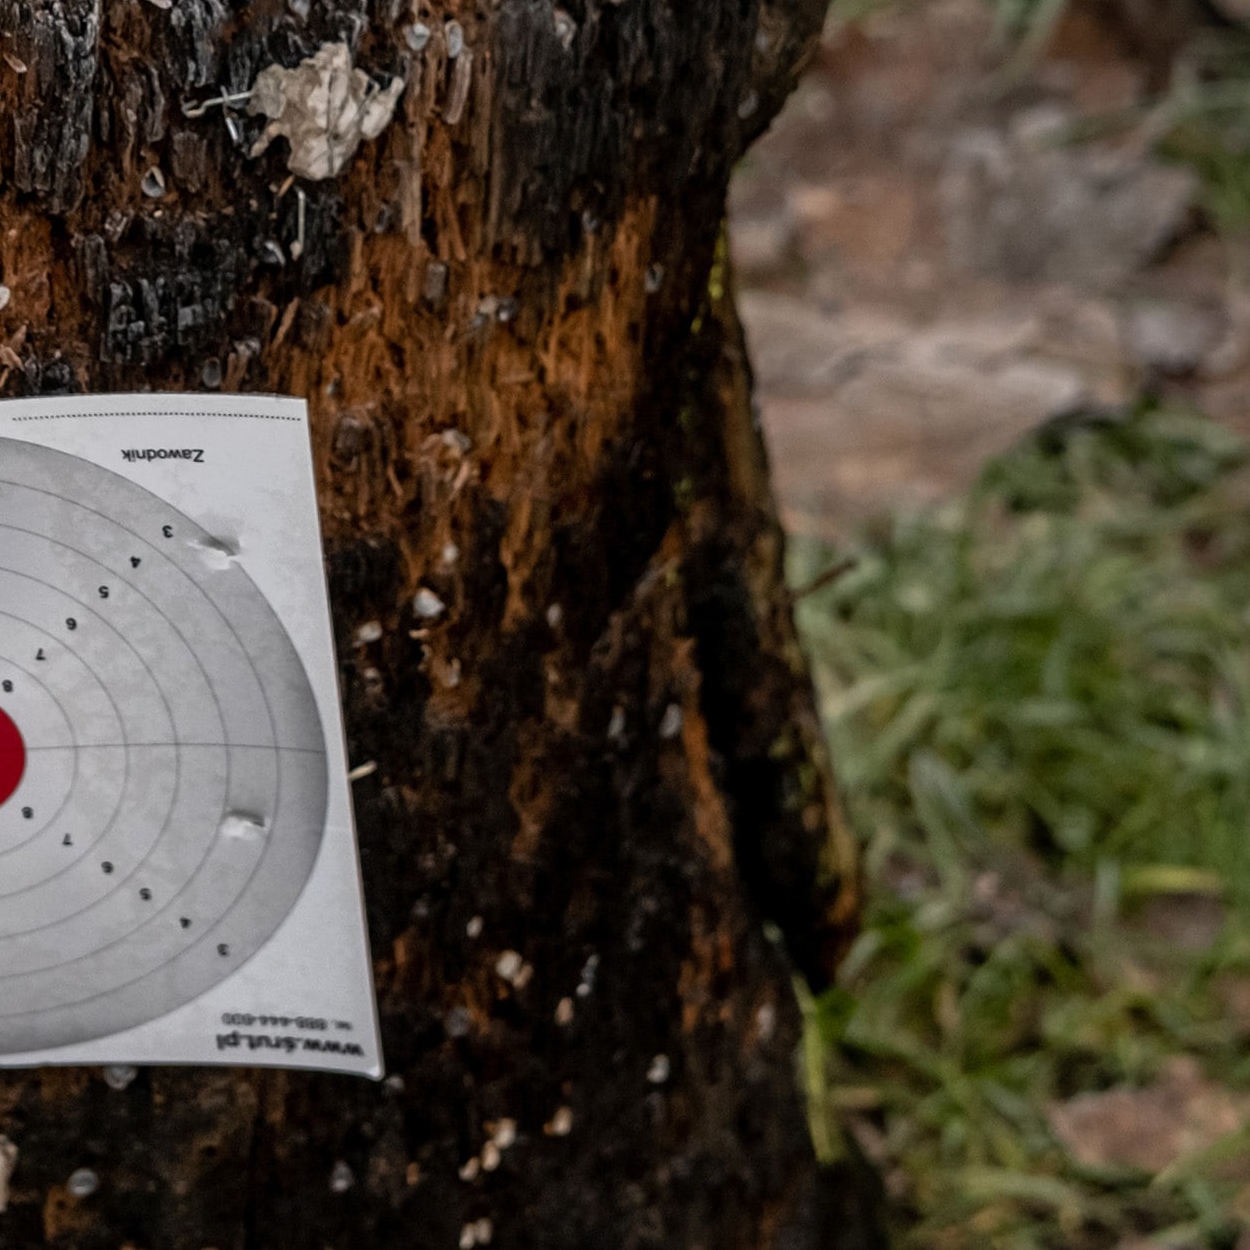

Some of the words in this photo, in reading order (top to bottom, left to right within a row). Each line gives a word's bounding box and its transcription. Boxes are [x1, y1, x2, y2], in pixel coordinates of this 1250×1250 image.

[120, 448, 205, 463] Zawodnik
[162, 525, 174, 540] 3
[130, 556, 142, 570] 4
[98, 585, 110, 600] 5
[65, 617, 78, 632] 6
[35, 648, 47, 662] 7
[1, 679, 14, 694] 8
[21, 806, 34, 820] 8
[62, 834, 73, 847] 7
[101, 861, 115, 875] 6
[139, 888, 152, 902] 5
[180, 917, 192, 930] 4
[217, 943, 229, 958] 3
